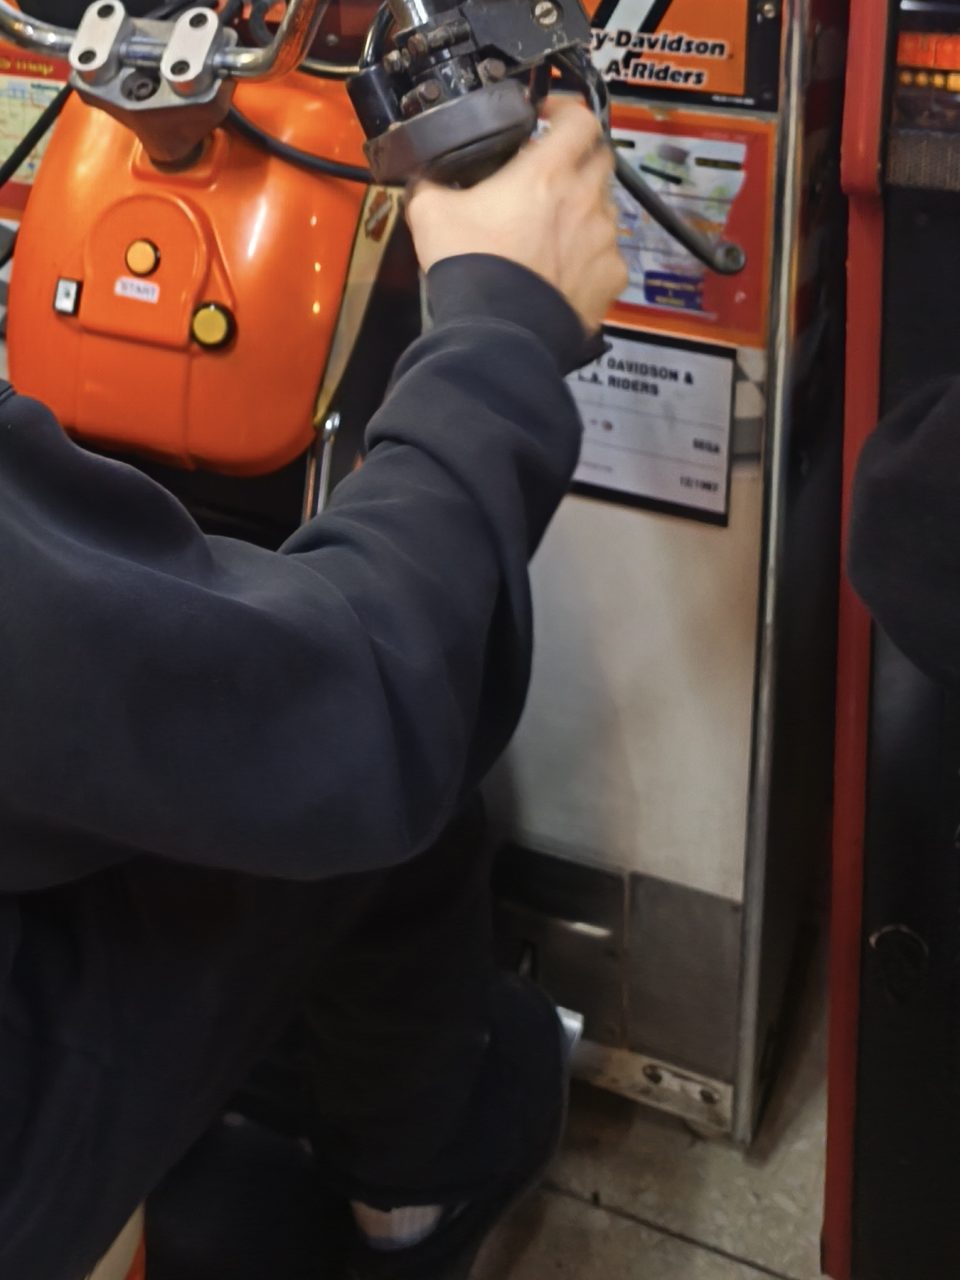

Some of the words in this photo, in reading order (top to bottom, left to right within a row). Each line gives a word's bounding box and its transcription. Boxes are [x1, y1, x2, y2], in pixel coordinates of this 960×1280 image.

[590, 29, 727, 59] y-Davidson
[606, 356, 680, 384] DAVIDSON
[607, 374, 660, 397] RIDERS
